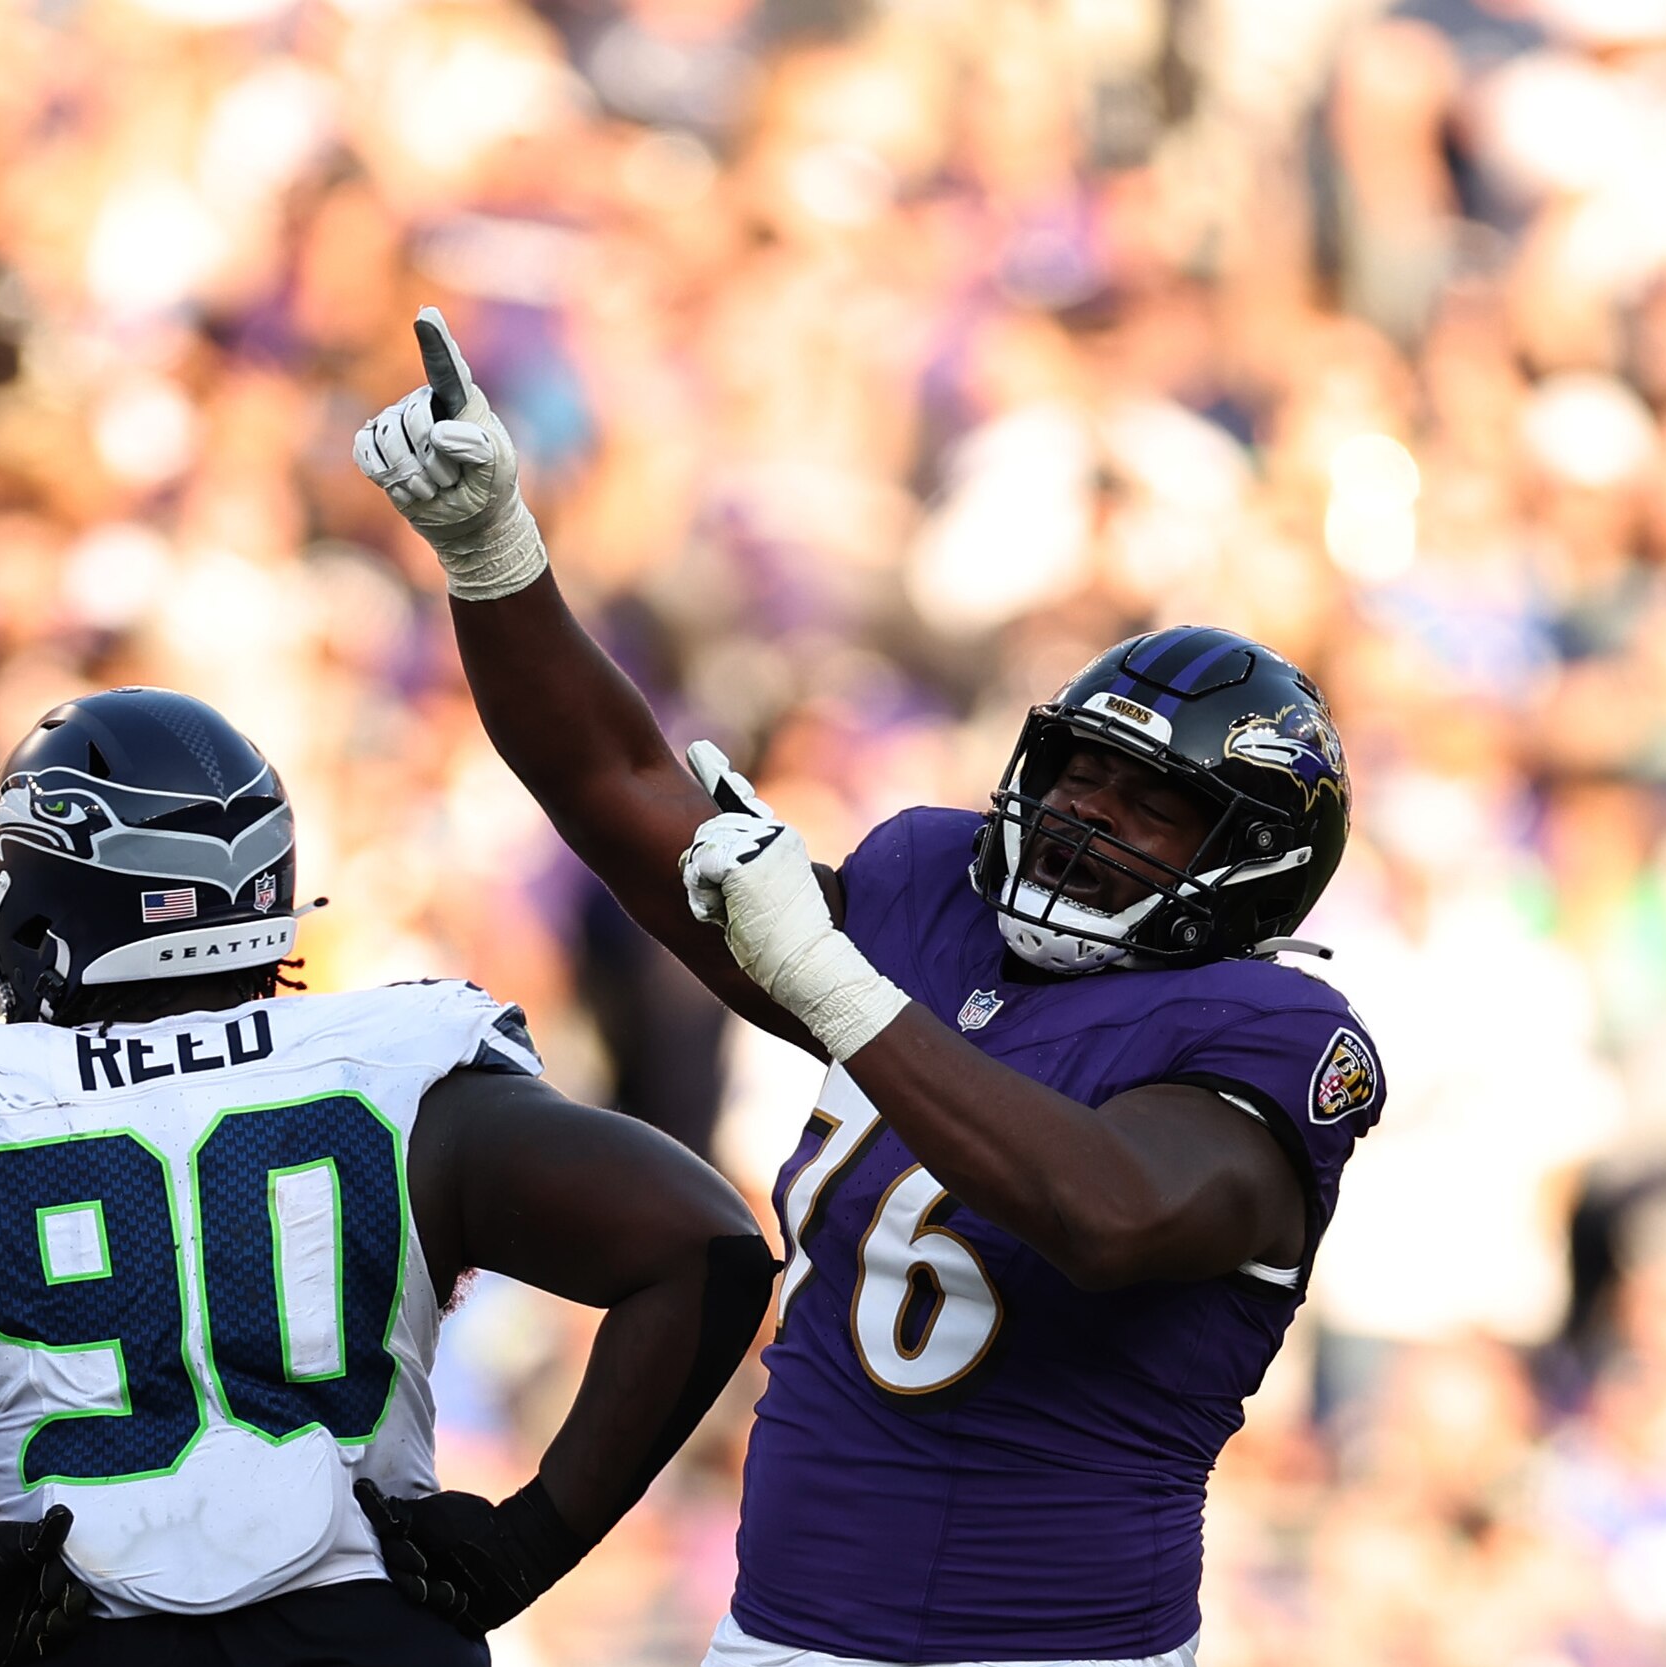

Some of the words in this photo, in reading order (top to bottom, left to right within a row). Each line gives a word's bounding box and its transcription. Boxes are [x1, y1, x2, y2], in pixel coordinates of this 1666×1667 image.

[1107, 696, 1154, 725] RAVENS
[159, 931, 287, 962] SEATTLE
[961, 1003, 986, 1023] NFL
[76, 1010, 274, 1092] REED
[777, 1058, 1005, 1396] 76
